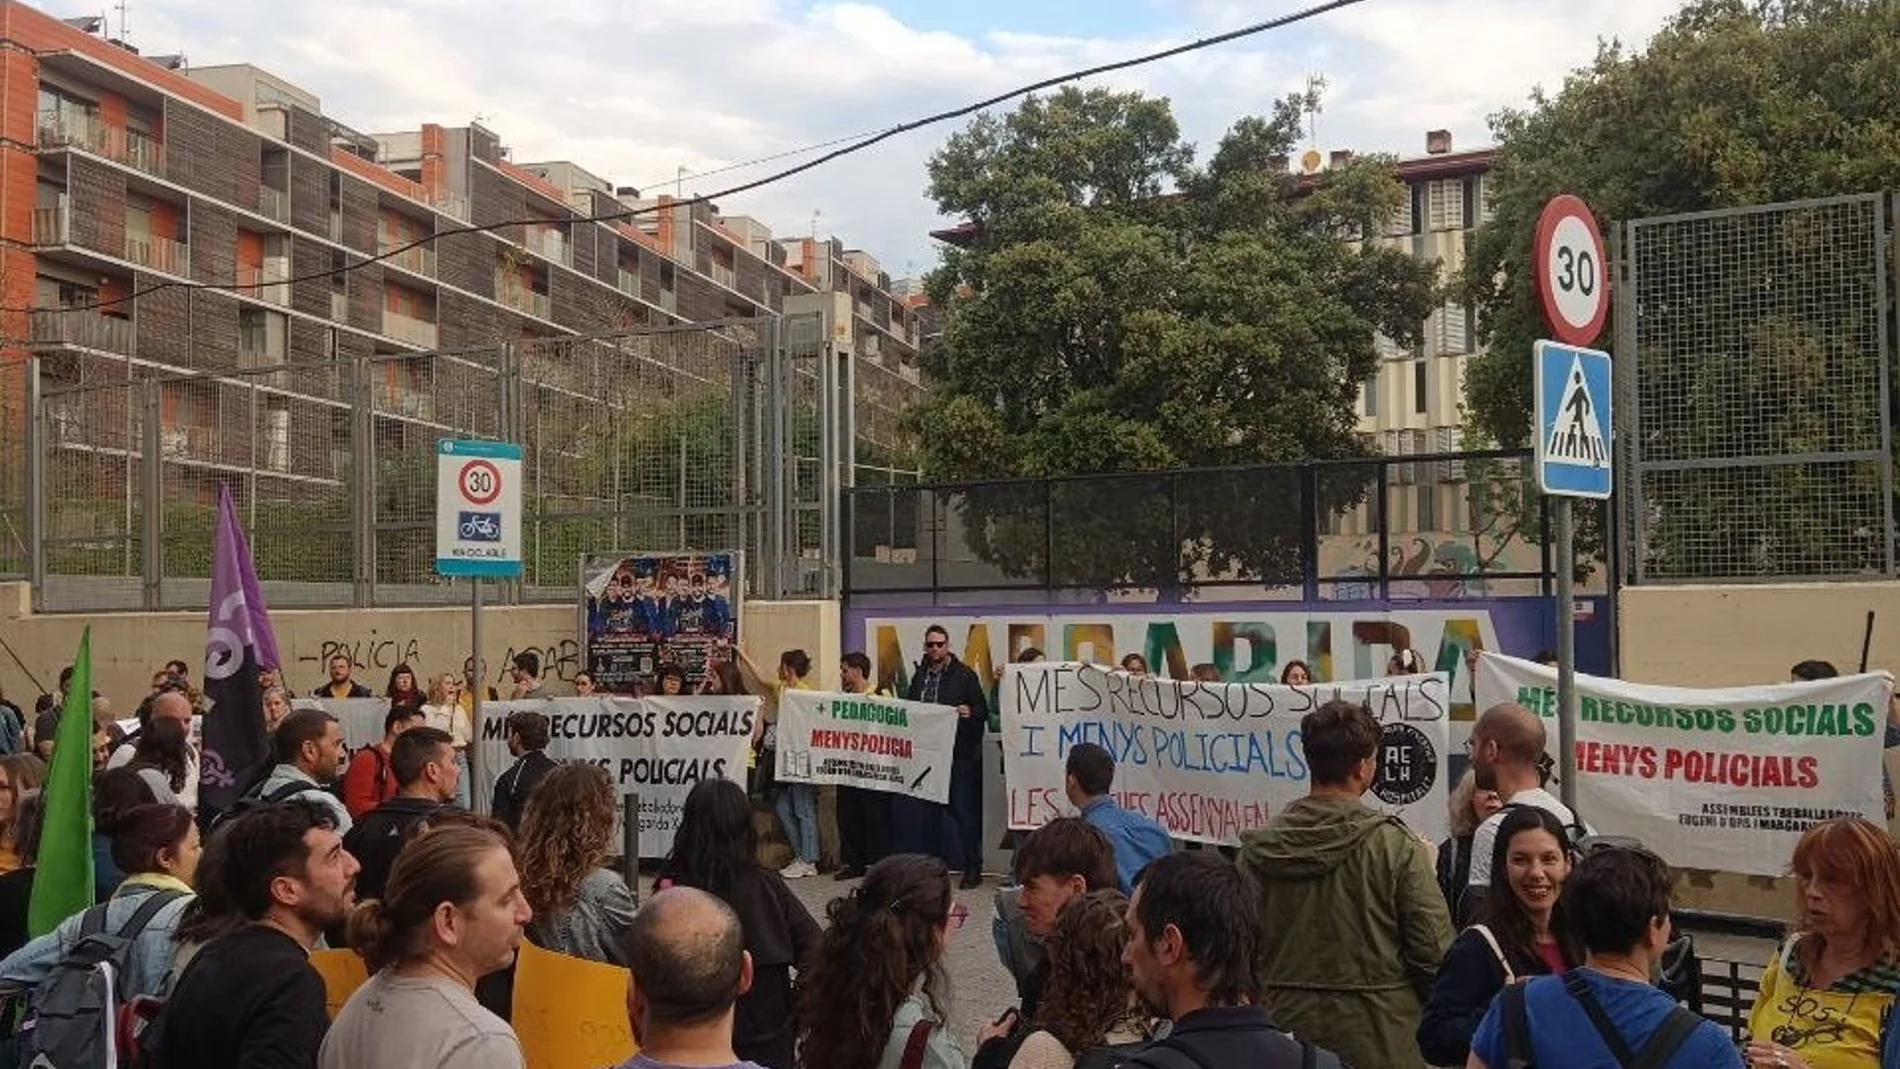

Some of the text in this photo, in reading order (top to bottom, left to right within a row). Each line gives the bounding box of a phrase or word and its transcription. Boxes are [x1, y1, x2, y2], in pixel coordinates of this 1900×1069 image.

[1558, 246, 1594, 296] 30
[470, 471, 491, 492] 30
[1016, 663, 1102, 714] MÉS
[1106, 672, 1274, 720] RECURSOS
[550, 711, 656, 740] ECURSOS
[662, 710, 754, 738] SOCIALS
[831, 701, 908, 727] PEDAGOGIA
[1518, 686, 1875, 737] MÉ RECURSOS SOCIALS
[810, 729, 913, 759] MENYS POLICIA
[1020, 726, 1045, 757] I
[1152, 725, 1307, 781] POLICIALS
[1664, 751, 1820, 789] POLICIALS
[1011, 787, 1061, 827] LES
